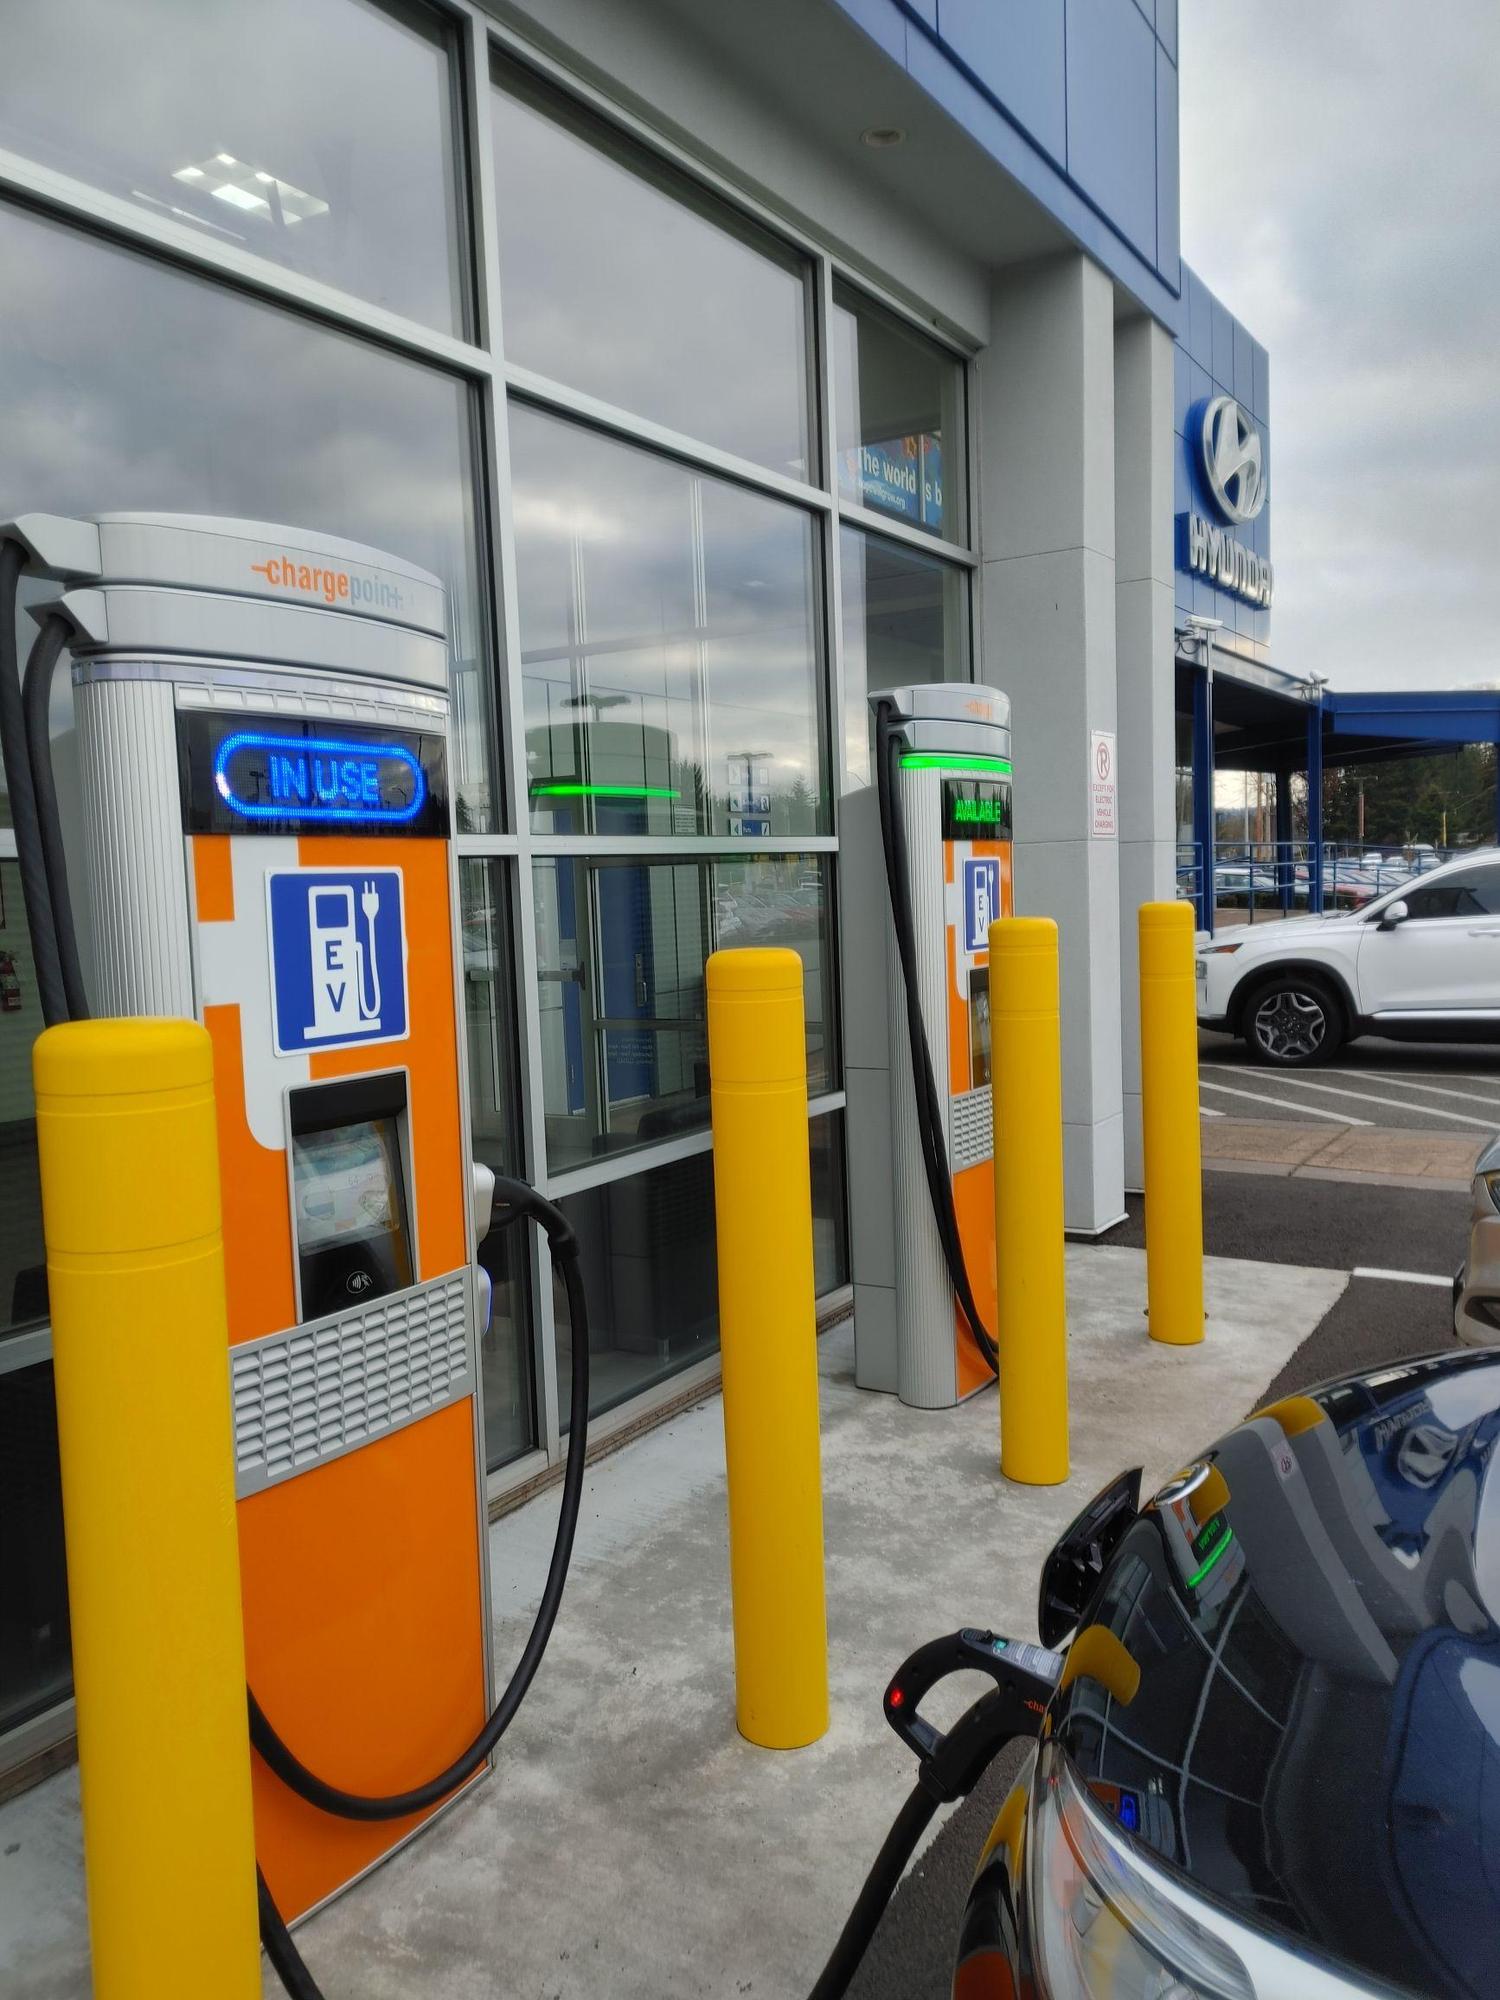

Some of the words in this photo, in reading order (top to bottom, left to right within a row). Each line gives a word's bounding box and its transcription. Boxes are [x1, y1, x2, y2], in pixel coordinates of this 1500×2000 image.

[883, 462, 916, 495] world
[1190, 512, 1274, 609] HYUNDAI
[270, 754, 307, 799] IN
[315, 759, 379, 801] USE
[955, 799, 1001, 822] AVAILABLE
[1095, 795, 1113, 805] ELECTRIC
[1096, 808, 1112, 817] VEHICLE
